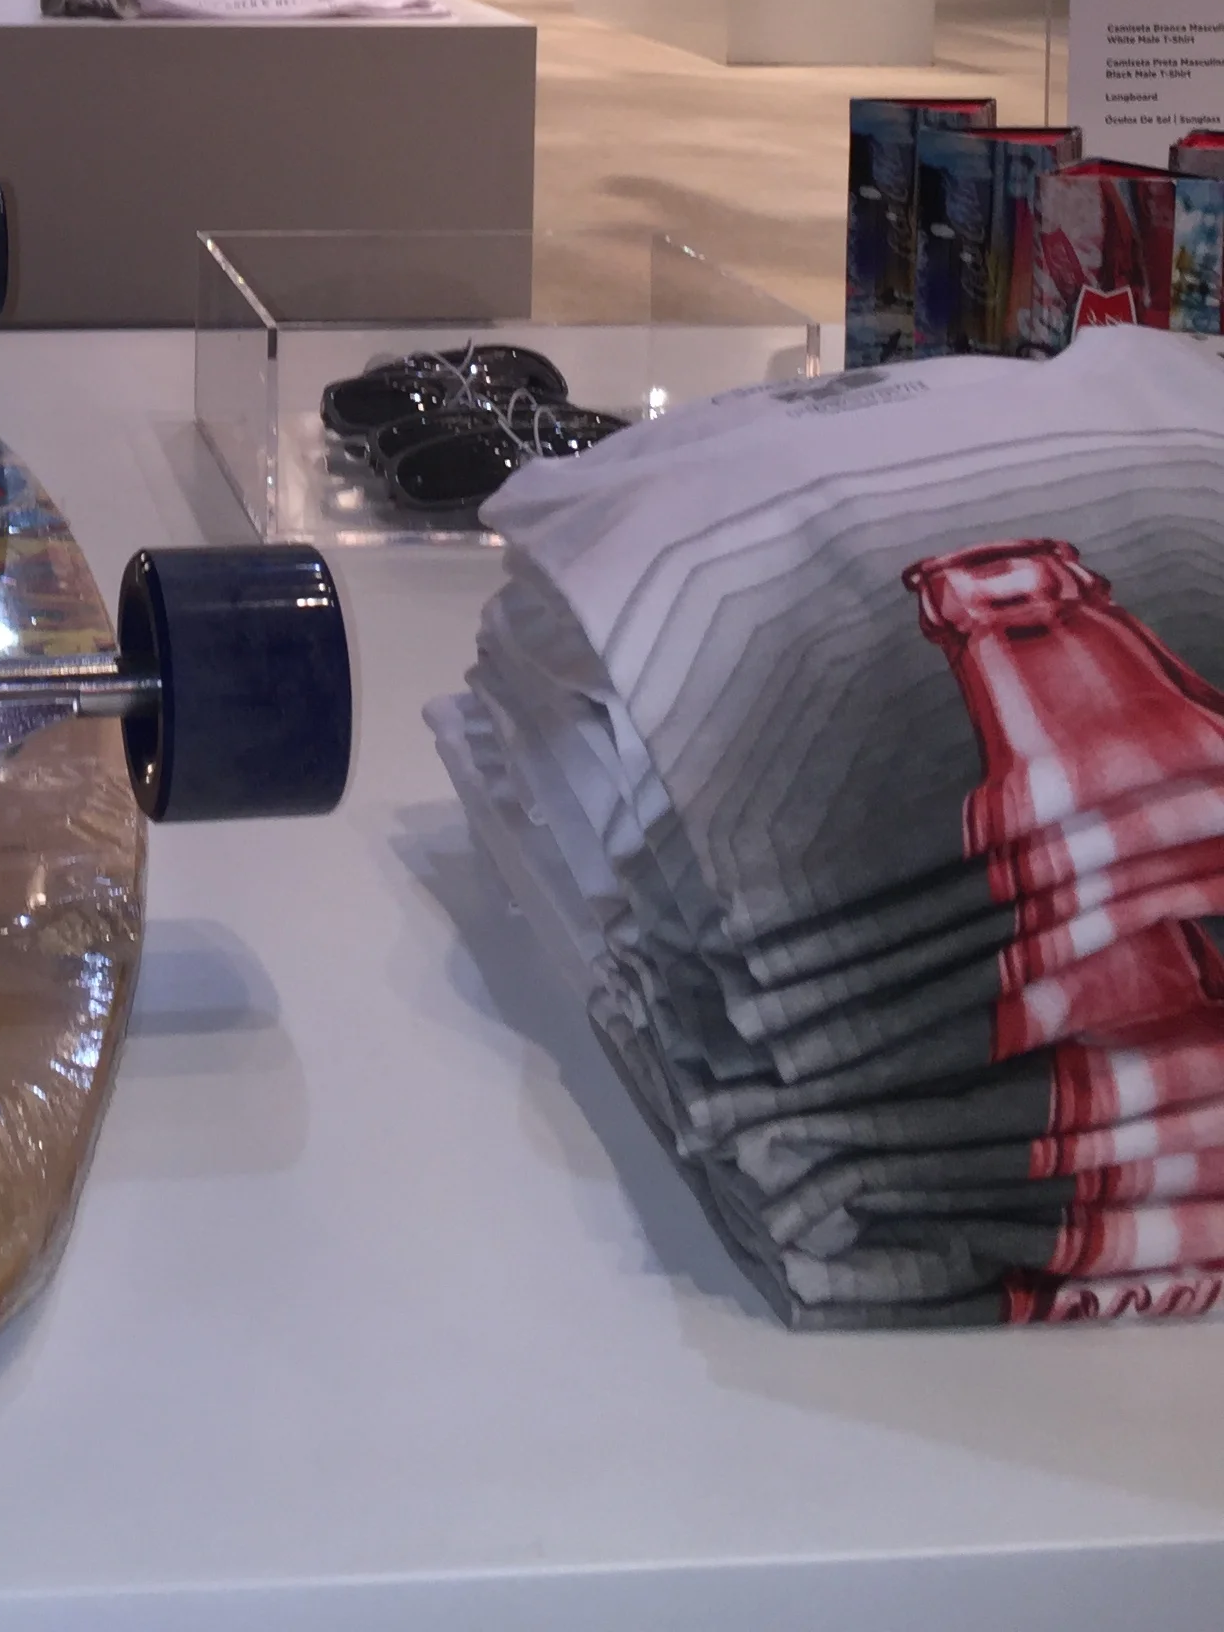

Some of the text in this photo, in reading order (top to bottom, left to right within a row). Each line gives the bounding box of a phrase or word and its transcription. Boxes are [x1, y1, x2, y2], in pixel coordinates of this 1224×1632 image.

[1107, 23, 1151, 33] Camiseta
[1153, 23, 1187, 33] Branca
[1107, 35, 1195, 44] White Male T-Shirt
[1106, 58, 1150, 67] Camiseta
[1153, 58, 1178, 67] Preta
[1106, 69, 1191, 79] Black Male T-Shirt
[1105, 92, 1158, 103] Longboard
